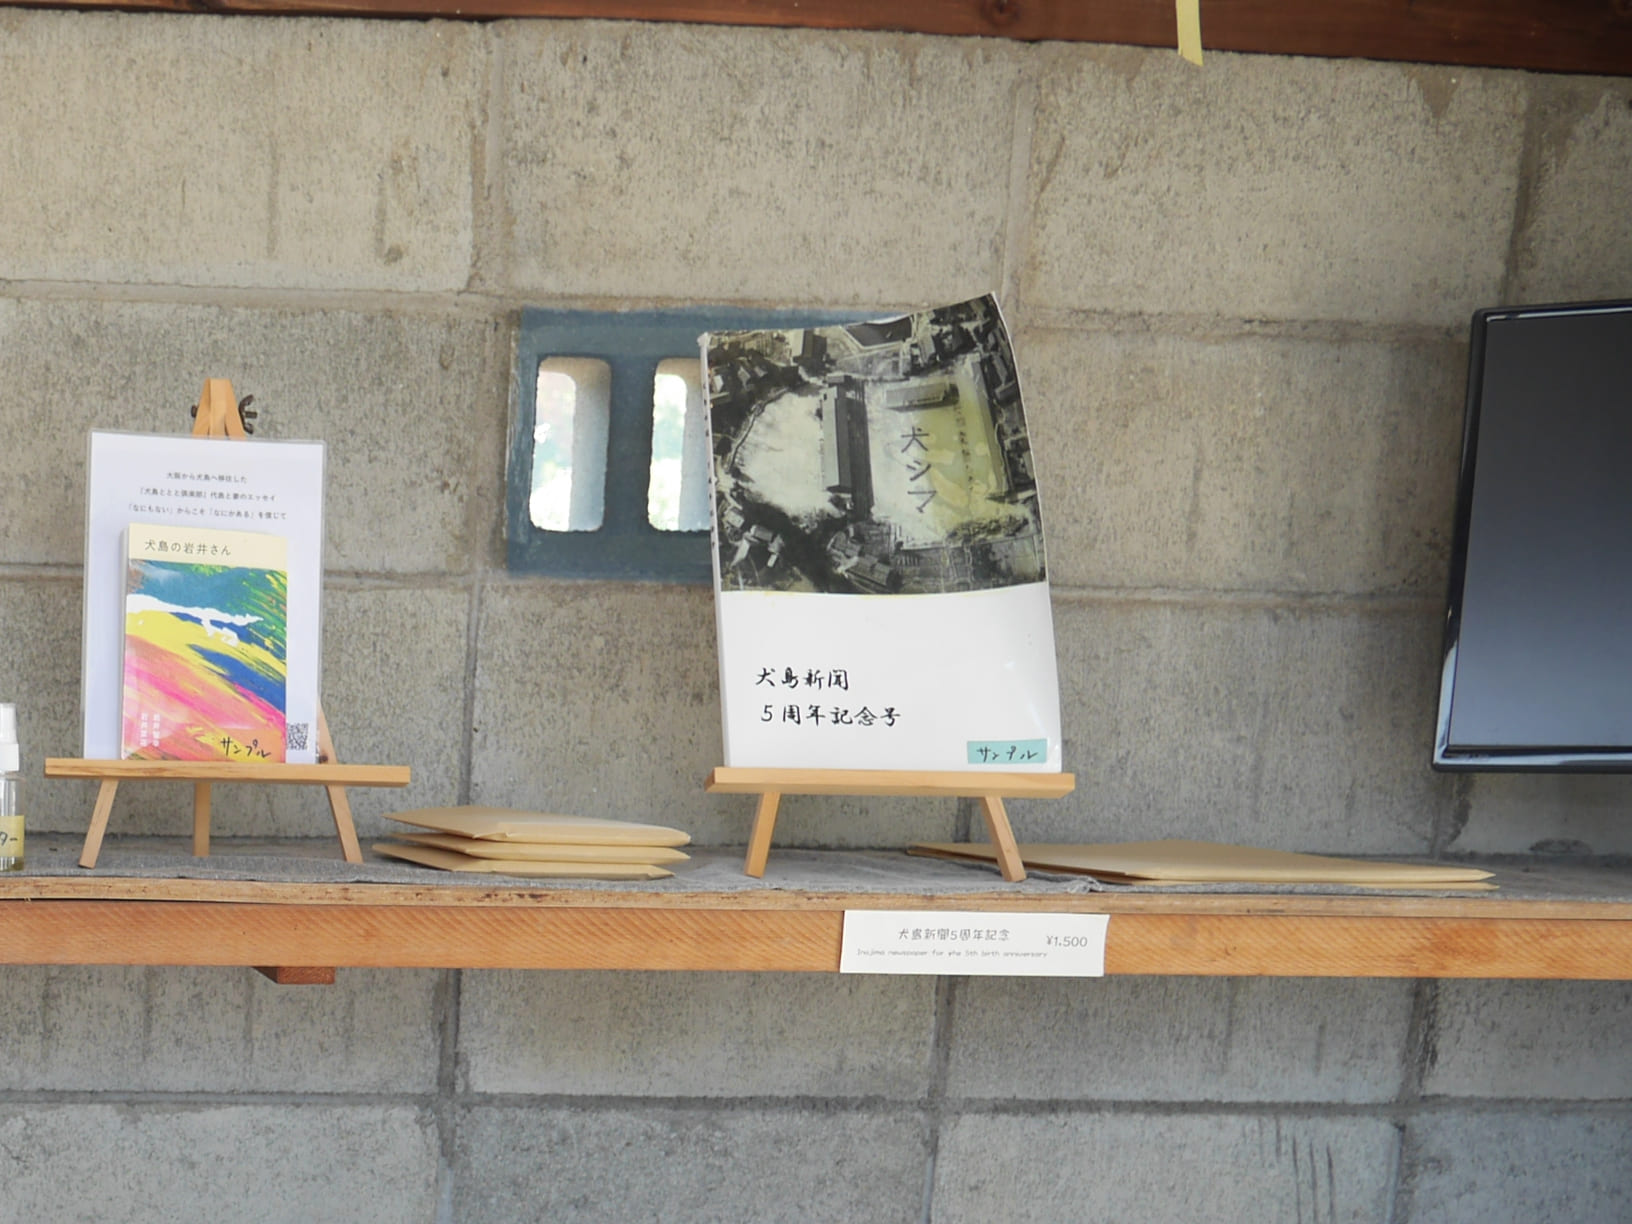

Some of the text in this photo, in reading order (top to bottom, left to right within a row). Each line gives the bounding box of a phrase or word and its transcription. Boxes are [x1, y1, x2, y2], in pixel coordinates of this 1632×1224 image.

[145, 540, 232, 556] 犬島の岩井さん
[755, 667, 850, 691] 犬島新聞
[220, 736, 271, 758] サンプル
